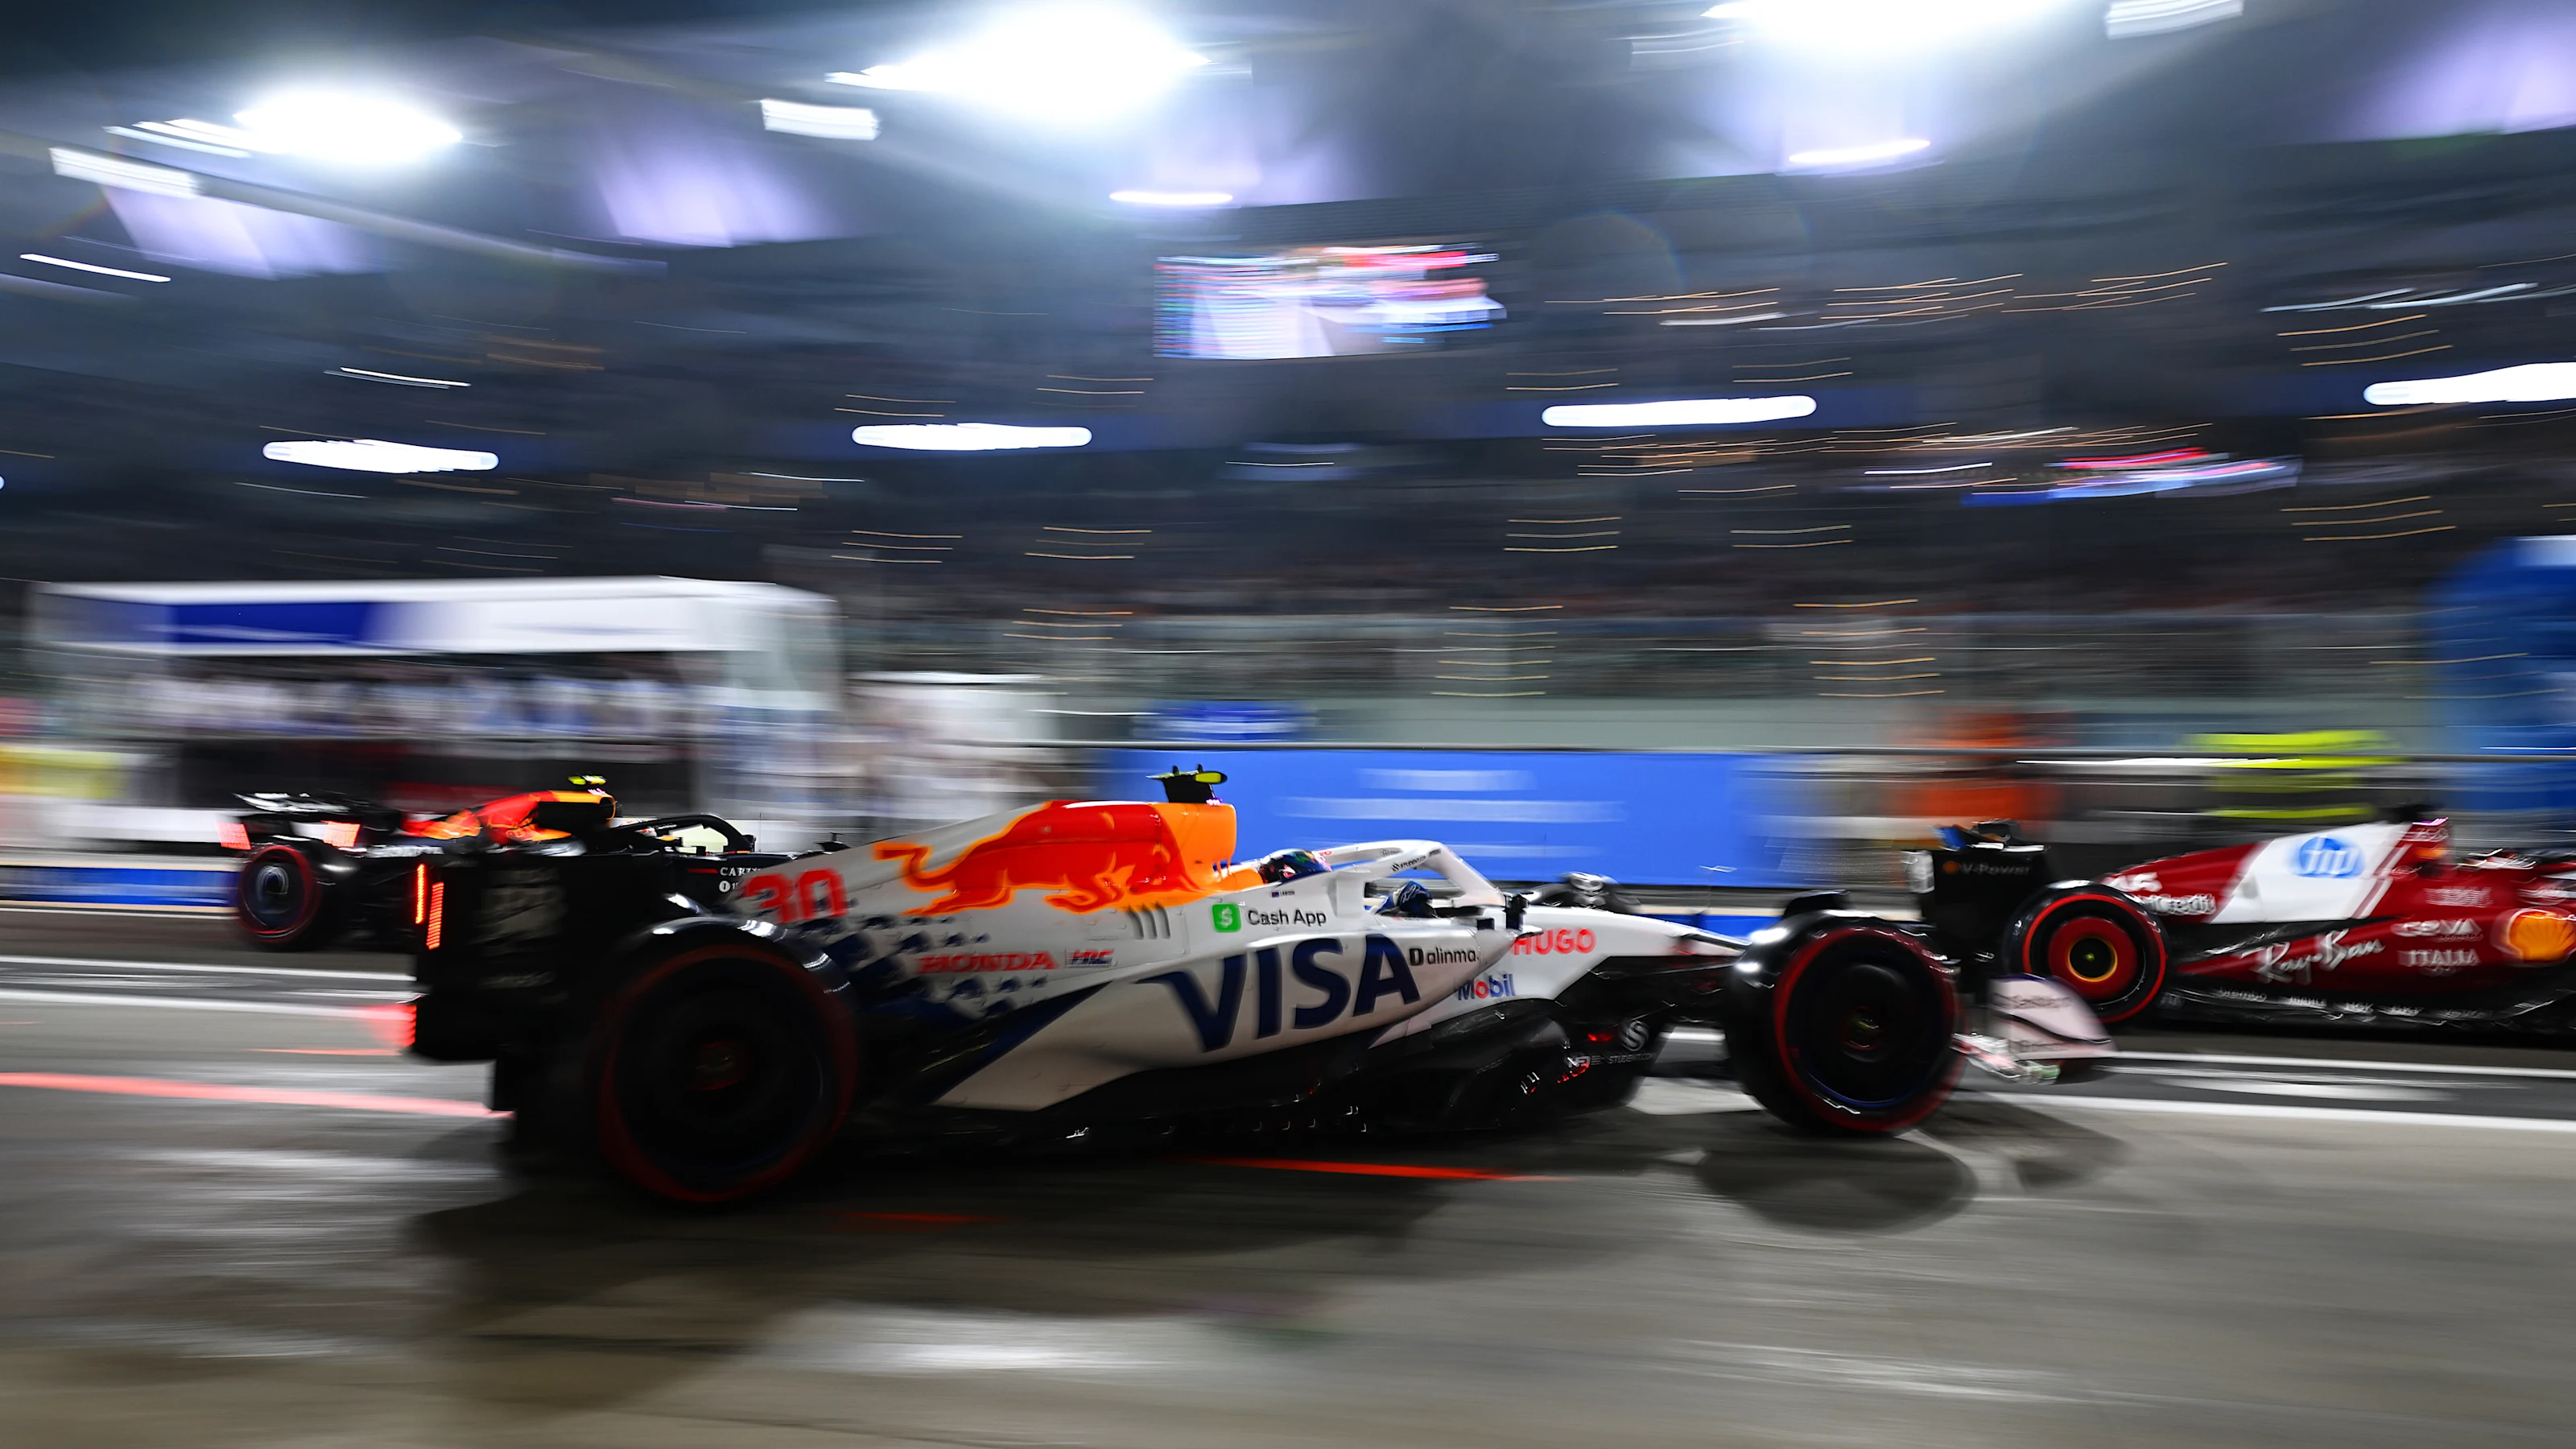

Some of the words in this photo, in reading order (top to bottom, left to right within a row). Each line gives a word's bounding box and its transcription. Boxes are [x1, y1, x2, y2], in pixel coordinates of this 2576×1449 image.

[1248, 909, 1290, 926] Cash
[1294, 910, 1327, 927] App
[1512, 928, 1597, 956] HUGO
[913, 950, 1060, 975] HONDA
[1133, 934, 1421, 1053] VISA
[1458, 973, 1517, 1001] Mobil
